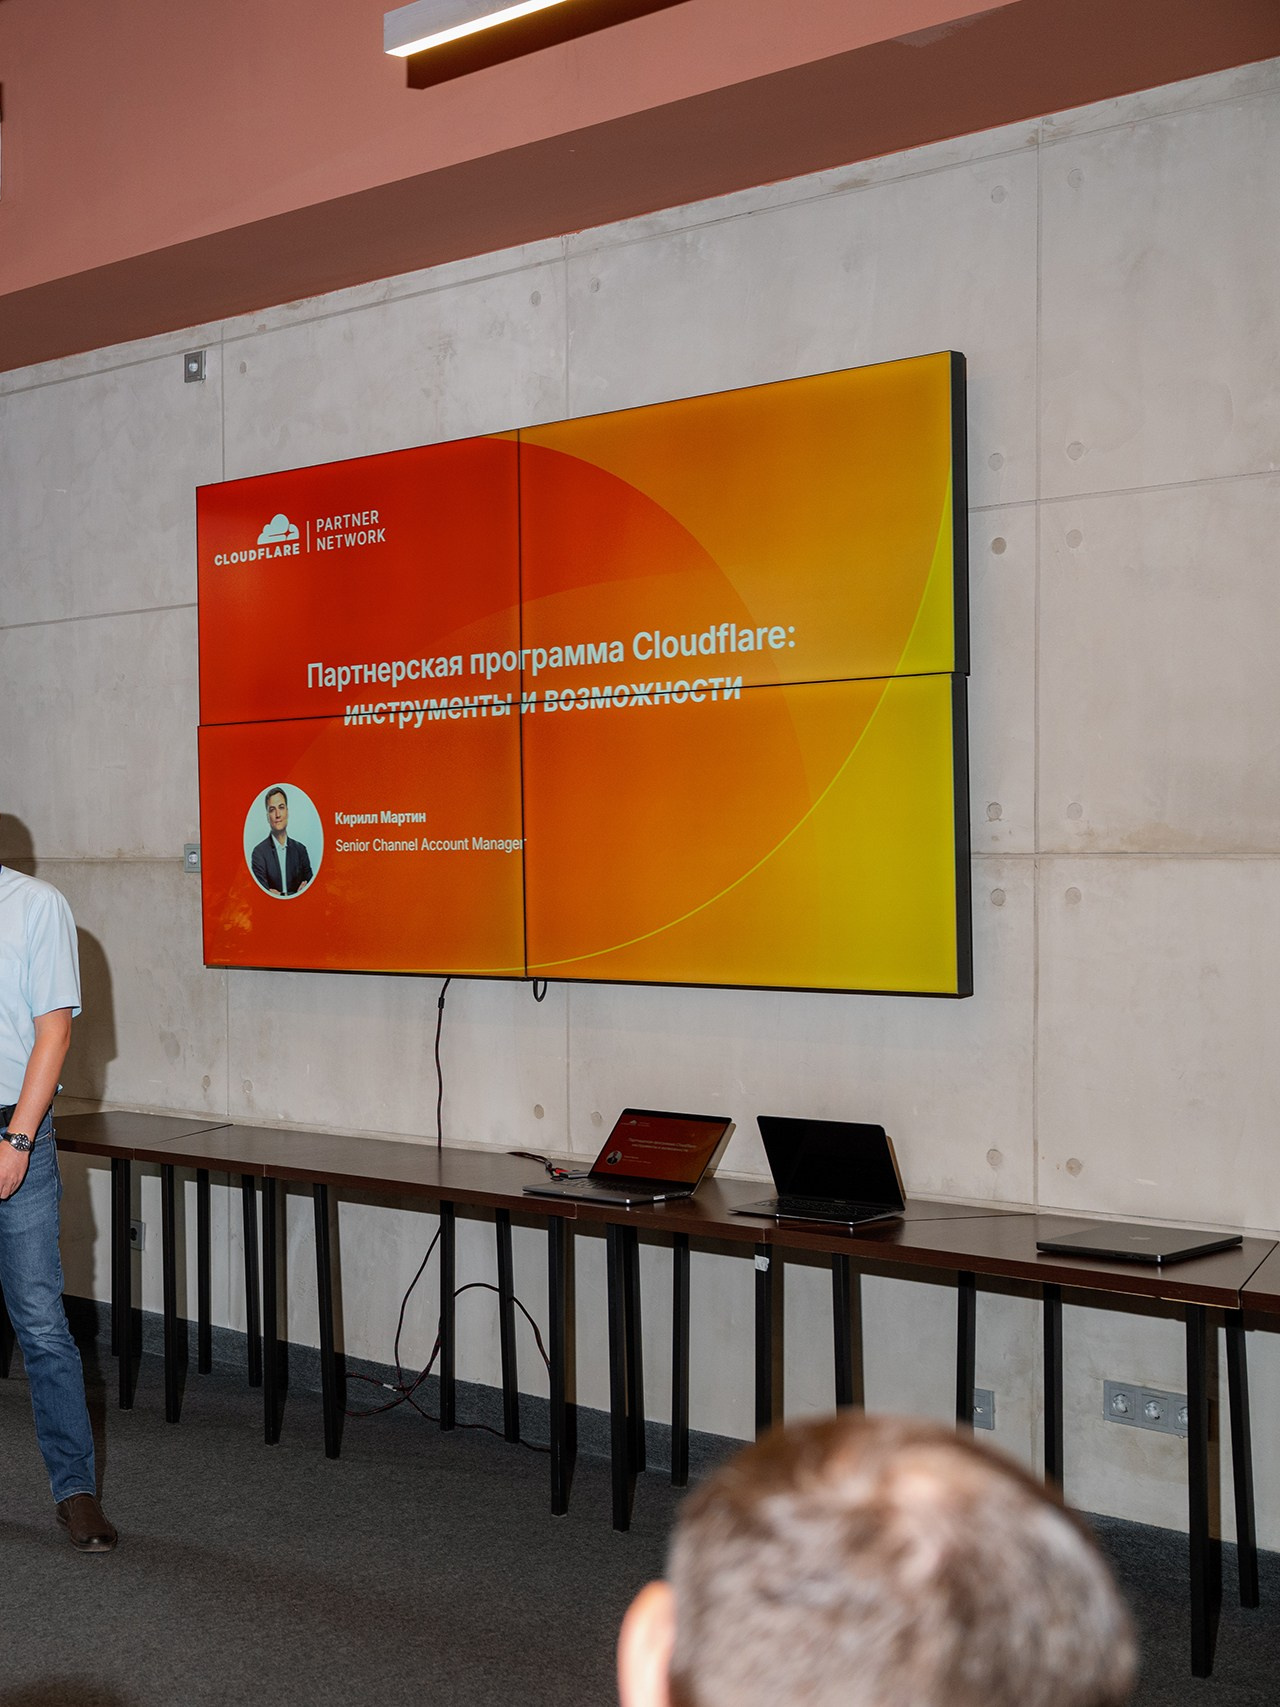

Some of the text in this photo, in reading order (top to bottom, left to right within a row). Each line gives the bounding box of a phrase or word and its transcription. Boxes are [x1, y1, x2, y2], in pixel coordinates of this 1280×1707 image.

[316, 510, 379, 533] PARTNER
[316, 528, 386, 552] NETWORK
[214, 543, 300, 566] CLOUDFLARE
[307, 623, 796, 692] Партнерская программа Cloudflare:
[343, 676, 742, 729] инструменты и возможности
[335, 811, 426, 827] Кирилл Мартин
[335, 837, 527, 853] Senior Channel Account Manager
